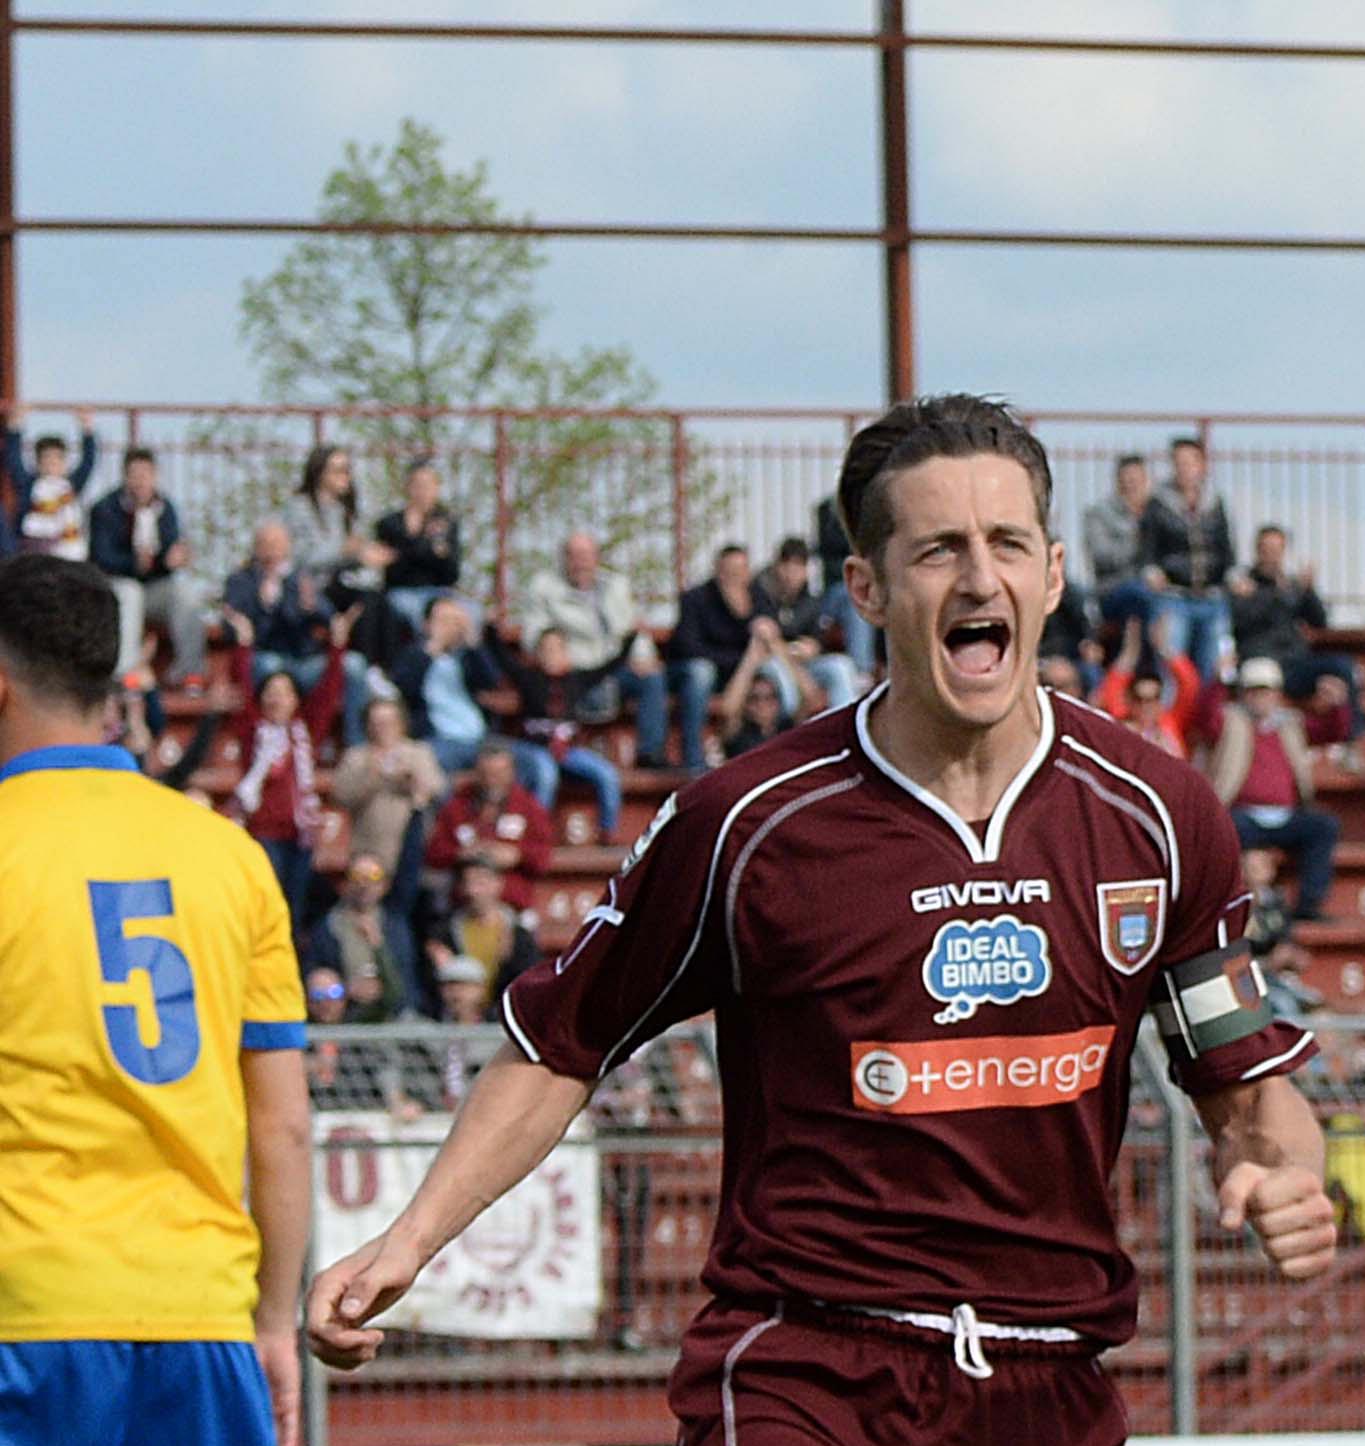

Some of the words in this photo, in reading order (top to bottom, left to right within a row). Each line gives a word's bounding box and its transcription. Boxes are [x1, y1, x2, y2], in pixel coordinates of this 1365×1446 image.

[911, 879, 1050, 912] GIVOVA
[946, 936, 1027, 961] IDEAL
[87, 878, 201, 1085] 5
[942, 962, 1033, 987] BIMBO
